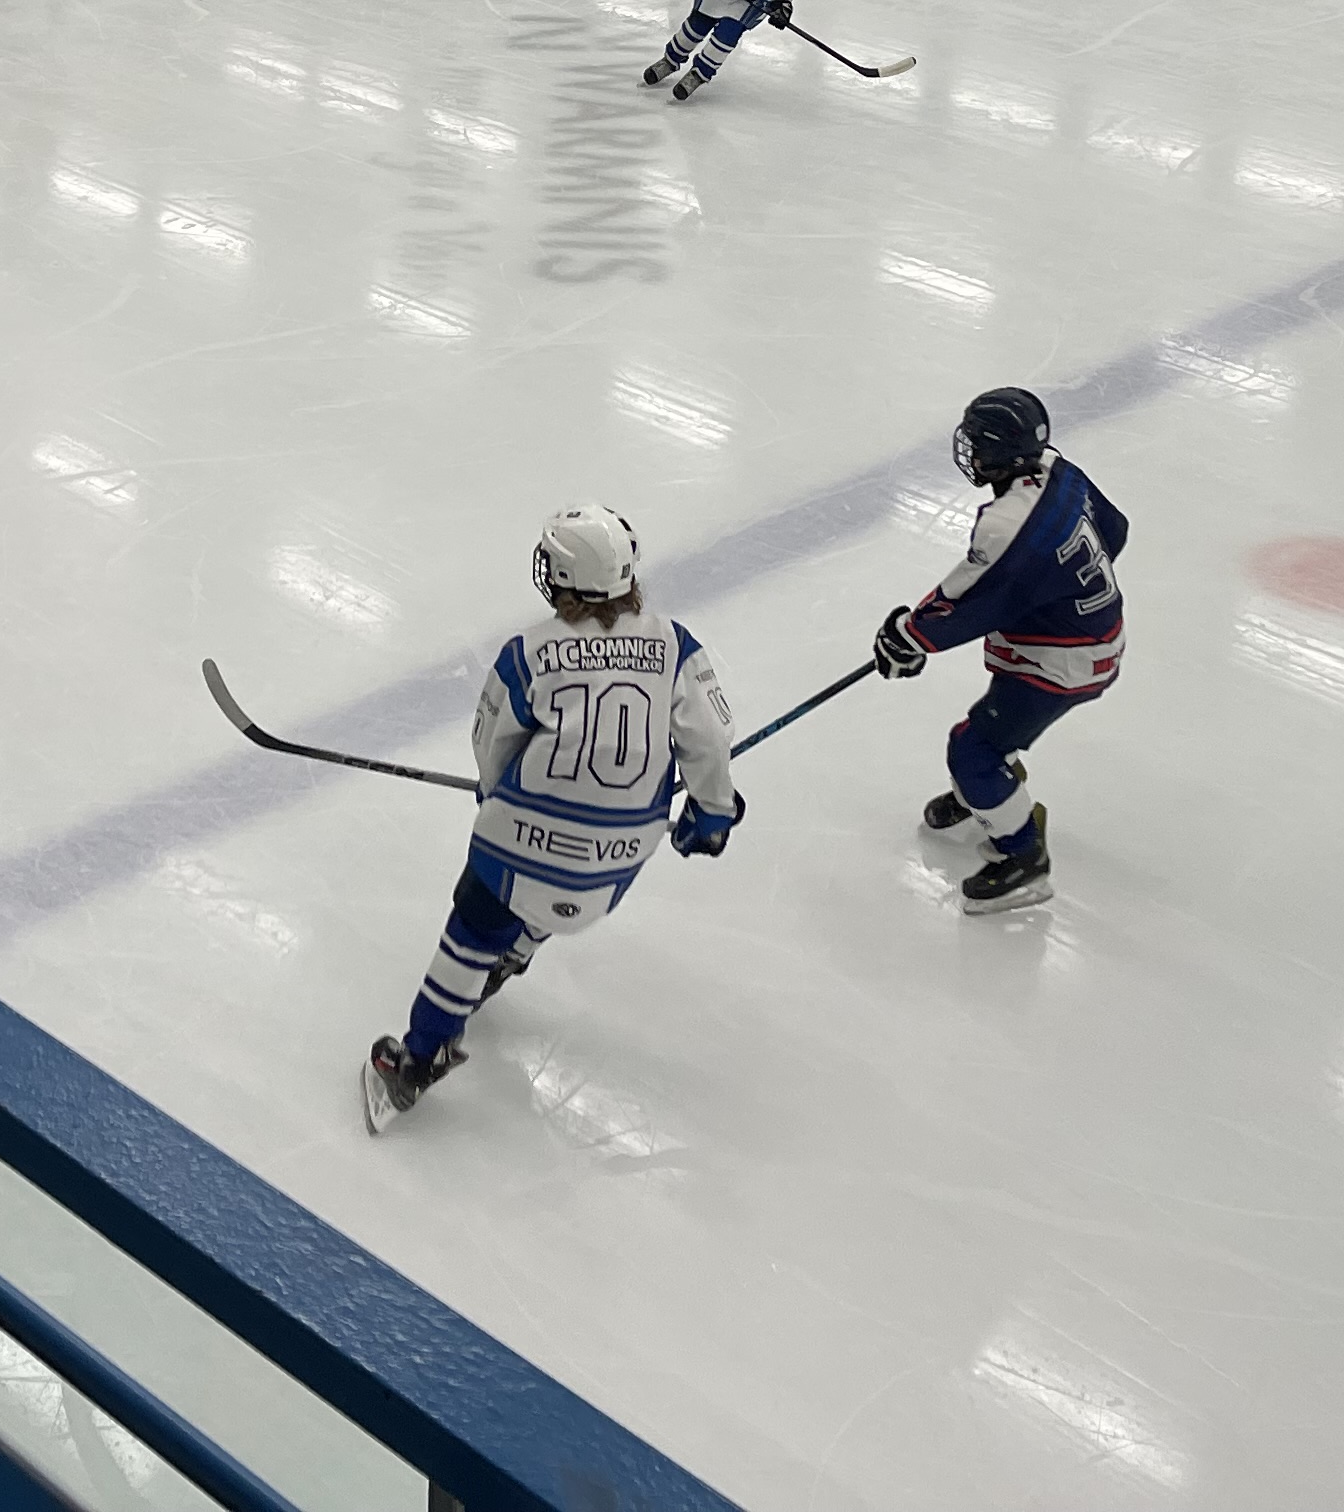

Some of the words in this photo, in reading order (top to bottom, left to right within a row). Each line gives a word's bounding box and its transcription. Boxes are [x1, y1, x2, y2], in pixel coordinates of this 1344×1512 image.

[537, 640, 581, 676] HC
[581, 638, 666, 660] LOMNICE
[581, 656, 607, 670] NAD
[547, 683, 651, 789] 10
